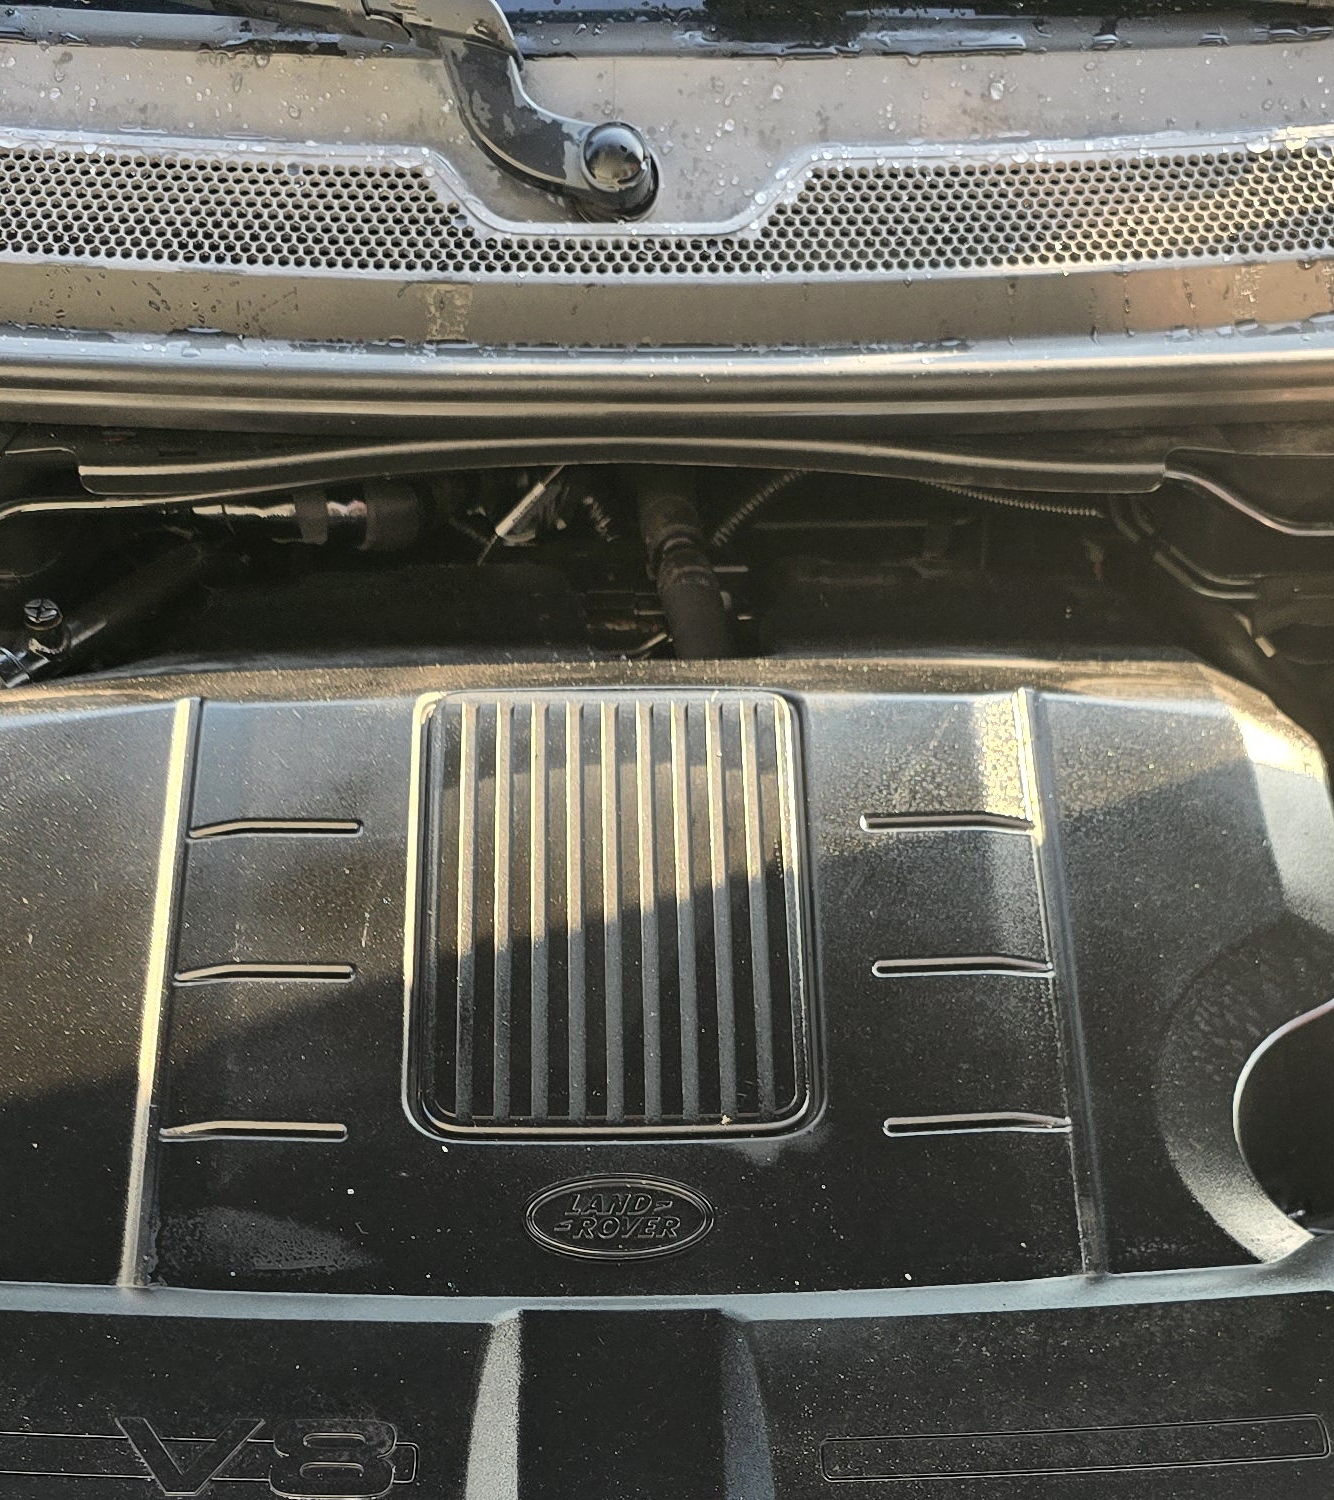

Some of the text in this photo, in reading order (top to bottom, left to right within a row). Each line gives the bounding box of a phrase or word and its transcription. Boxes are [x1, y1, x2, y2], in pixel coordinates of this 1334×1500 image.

[565, 1193, 652, 1216] LAND
[572, 1216, 681, 1240] ROVER
[114, 1416, 397, 1500] V8
